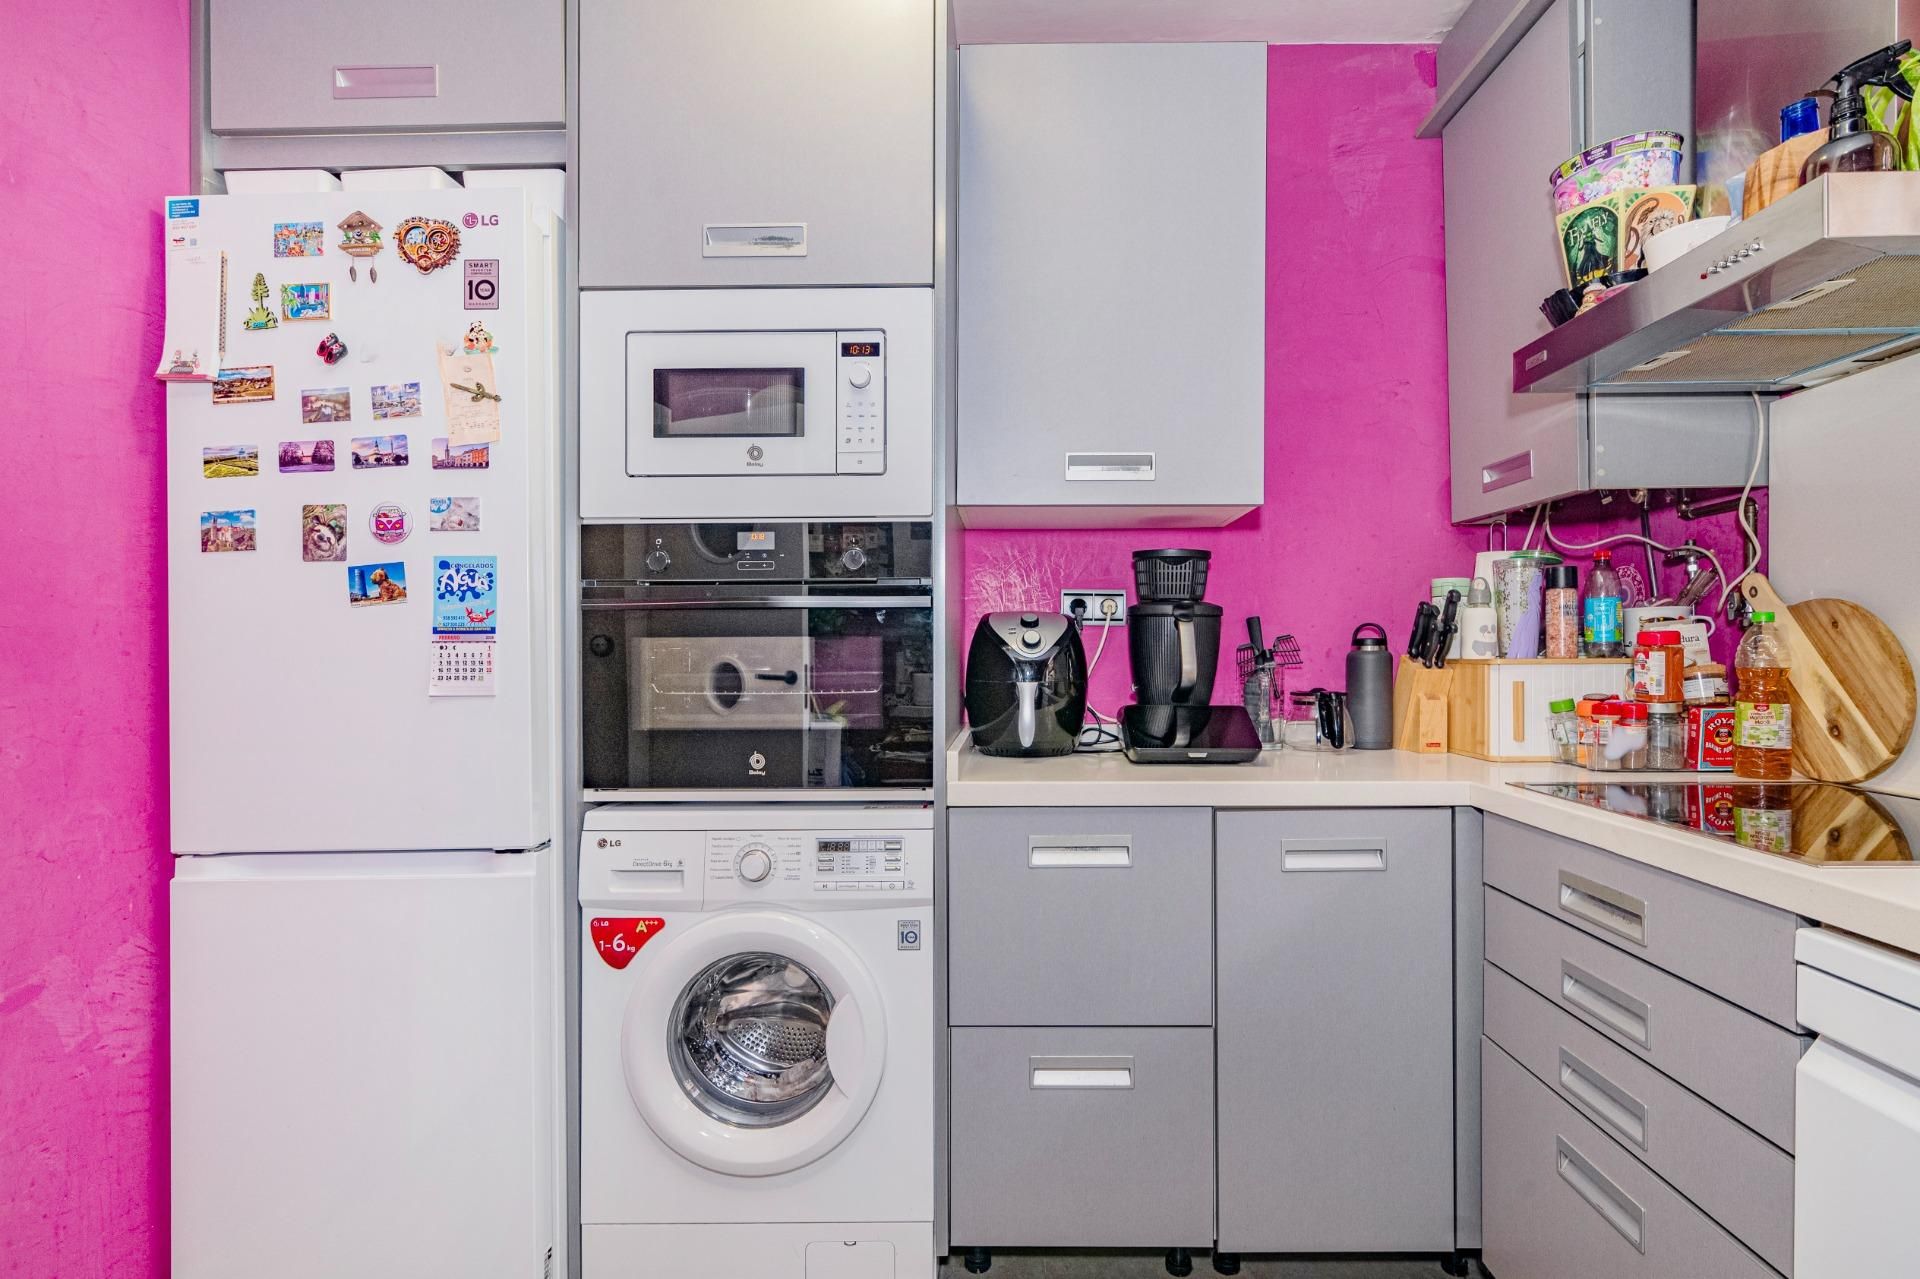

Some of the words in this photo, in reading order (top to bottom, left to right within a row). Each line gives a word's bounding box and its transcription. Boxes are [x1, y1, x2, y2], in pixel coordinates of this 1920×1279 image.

[481, 214, 499, 226] LG
[467, 279, 496, 301] 10
[849, 345, 871, 355] 10:13
[1708, 717, 1735, 731] ROYA
[609, 839, 622, 847] LG
[635, 919, 659, 933] A+++
[900, 930, 918, 944] 10
[626, 944, 636, 953] kg
